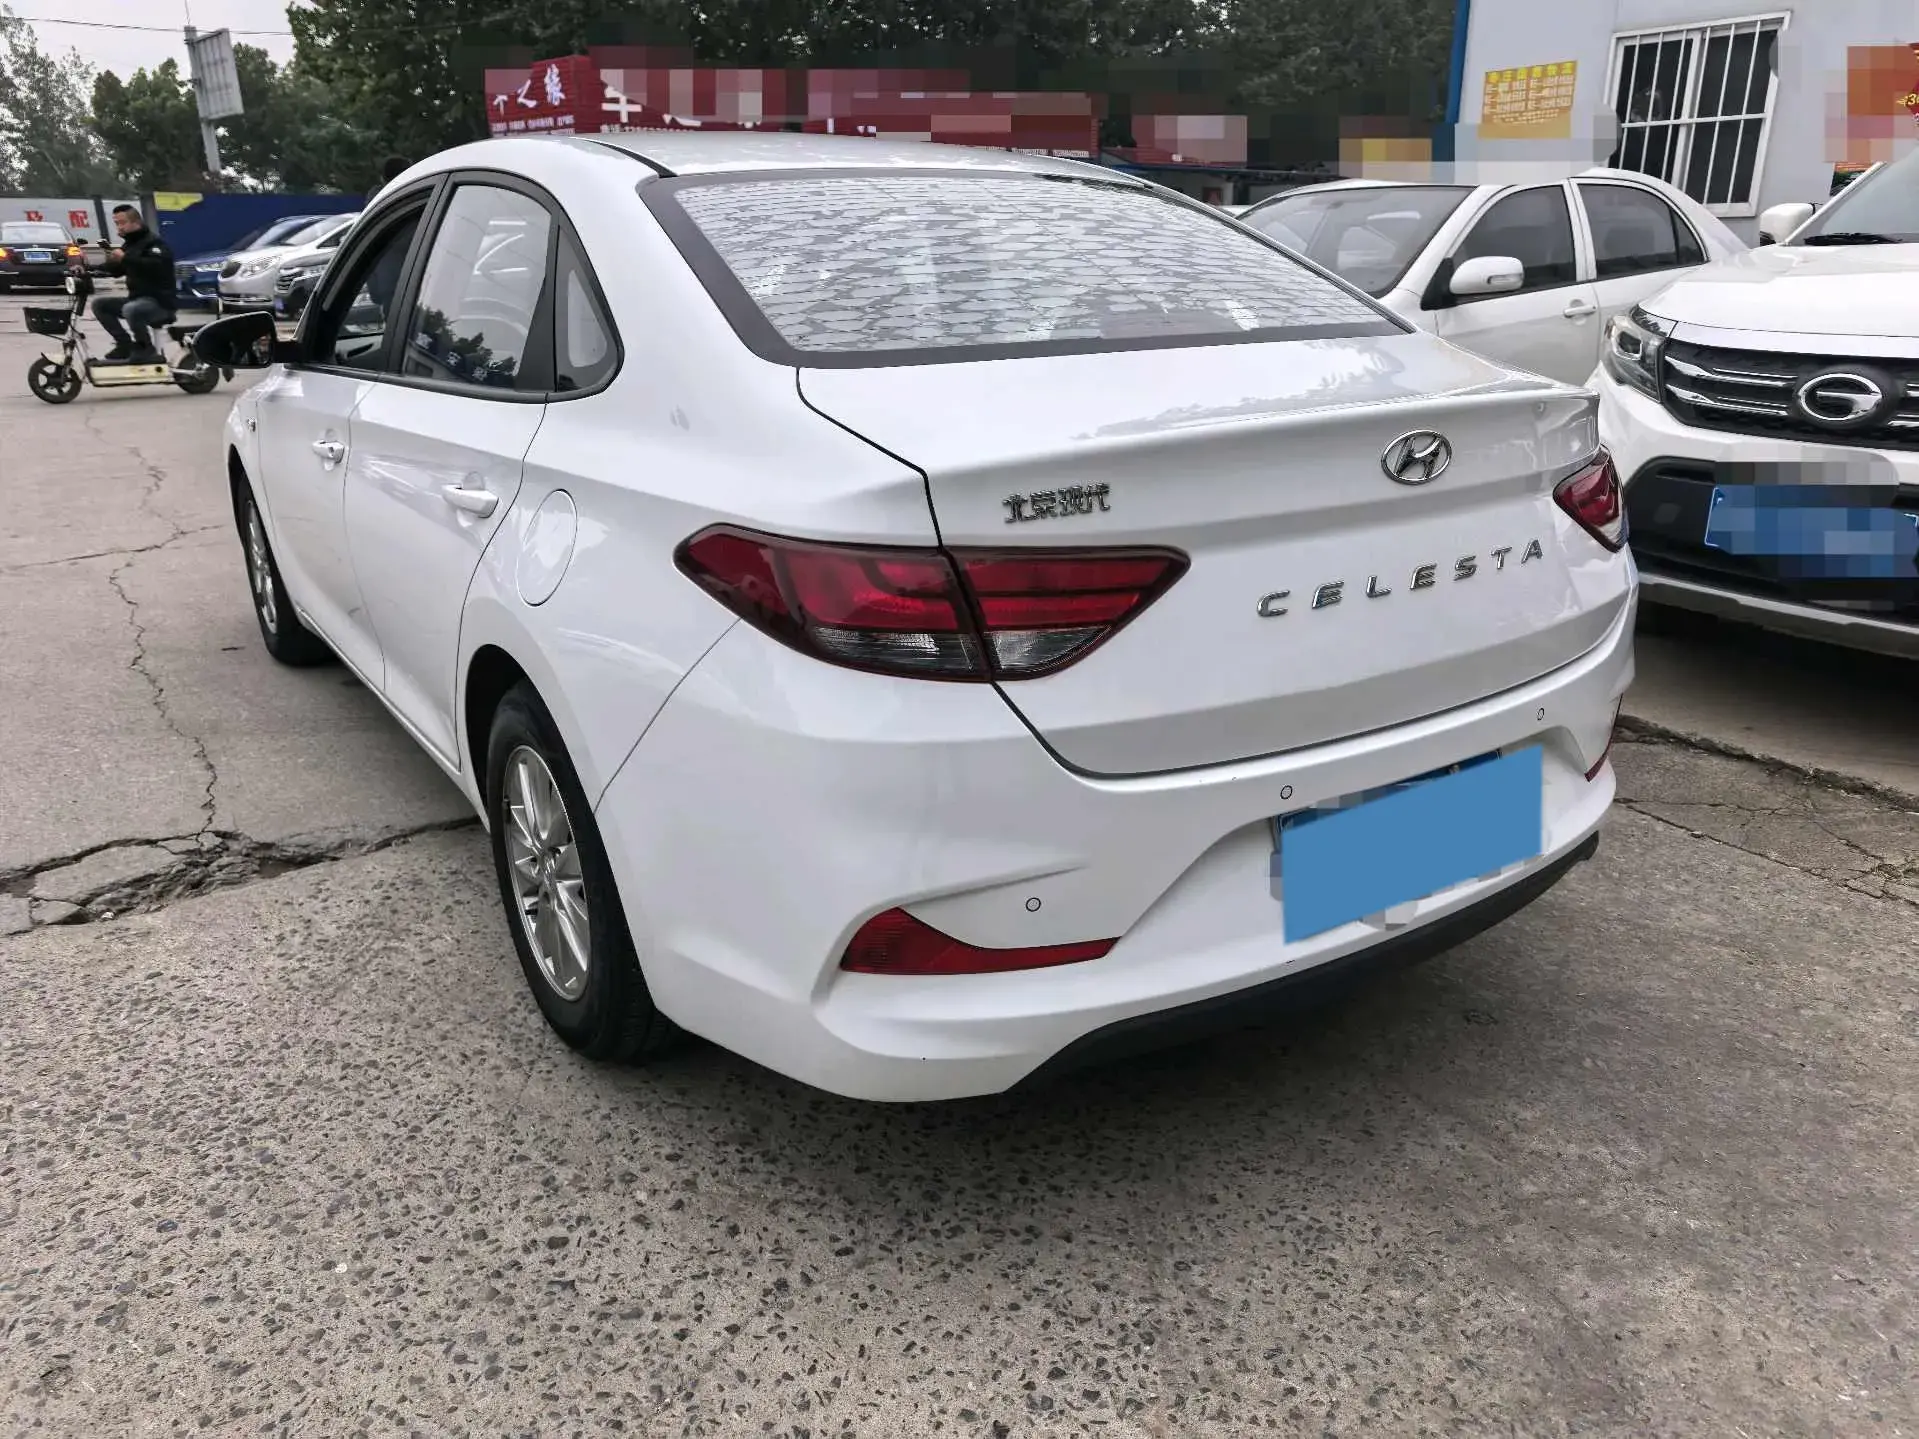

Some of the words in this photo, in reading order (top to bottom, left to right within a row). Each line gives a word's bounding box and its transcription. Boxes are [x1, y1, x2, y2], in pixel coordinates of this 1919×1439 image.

[1002, 482, 1112, 523] 北京现代
[1256, 539, 1544, 617] CELESTA
